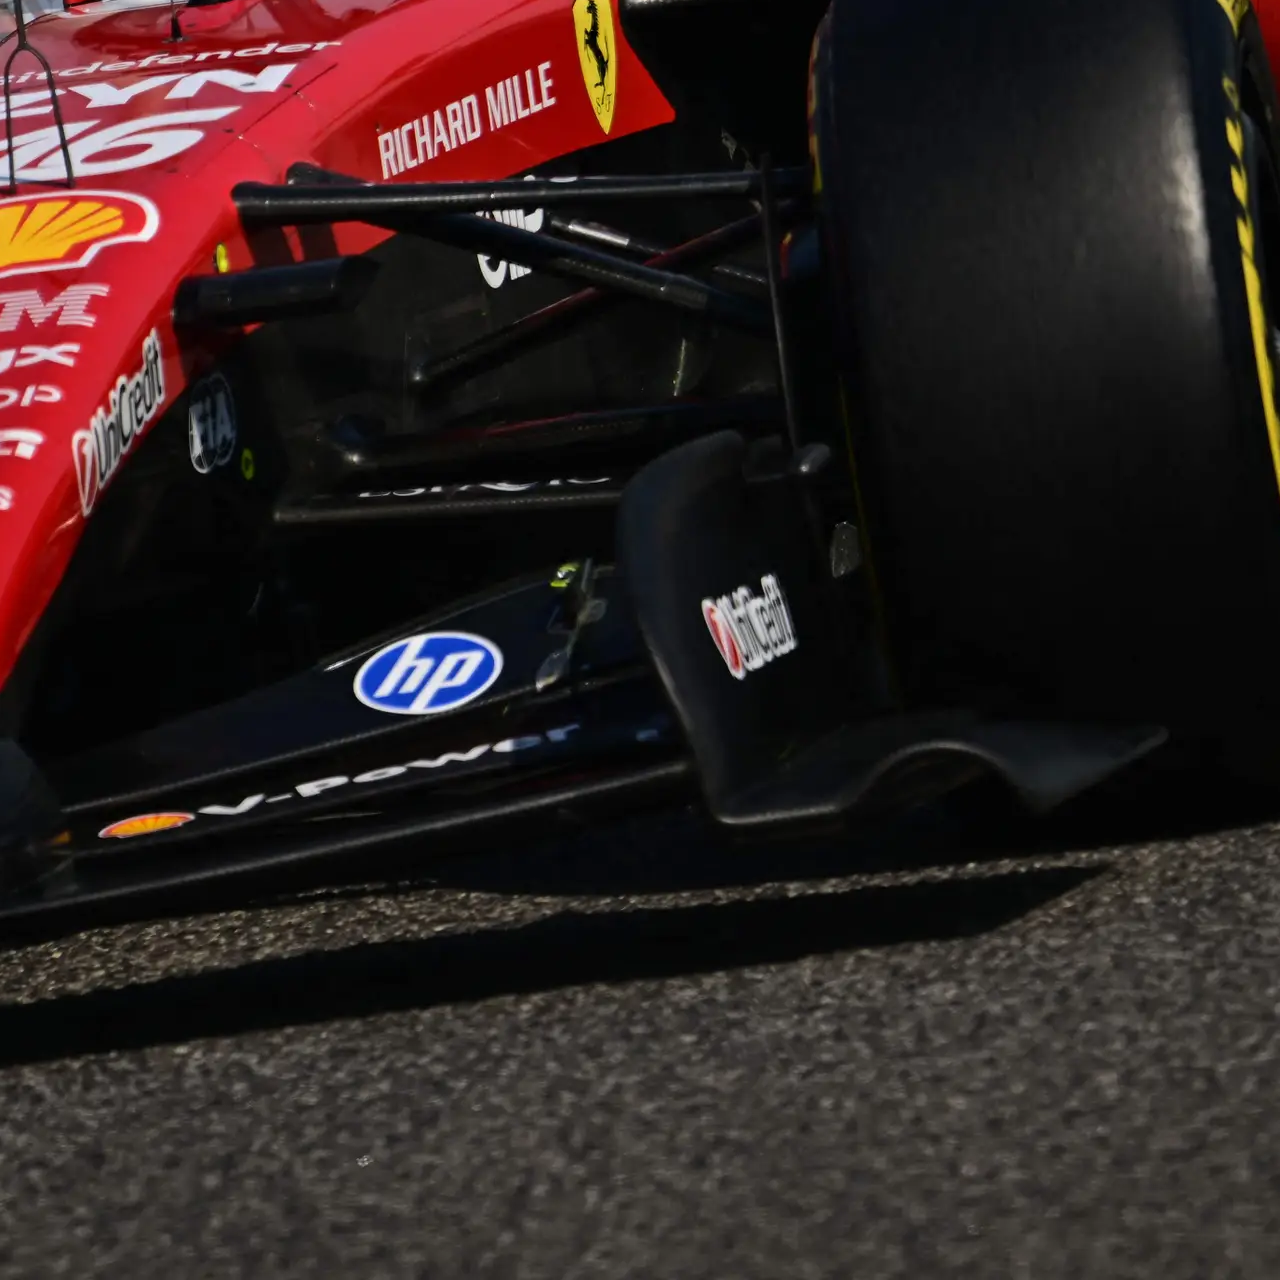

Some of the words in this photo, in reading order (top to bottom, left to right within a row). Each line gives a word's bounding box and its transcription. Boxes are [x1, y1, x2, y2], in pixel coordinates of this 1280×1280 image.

[376, 94, 482, 180] RICHARD
[485, 61, 556, 131] MILLE
[91, 328, 164, 488] UniCredit
[366, 634, 492, 712] hp
[197, 724, 581, 816] V-Power
